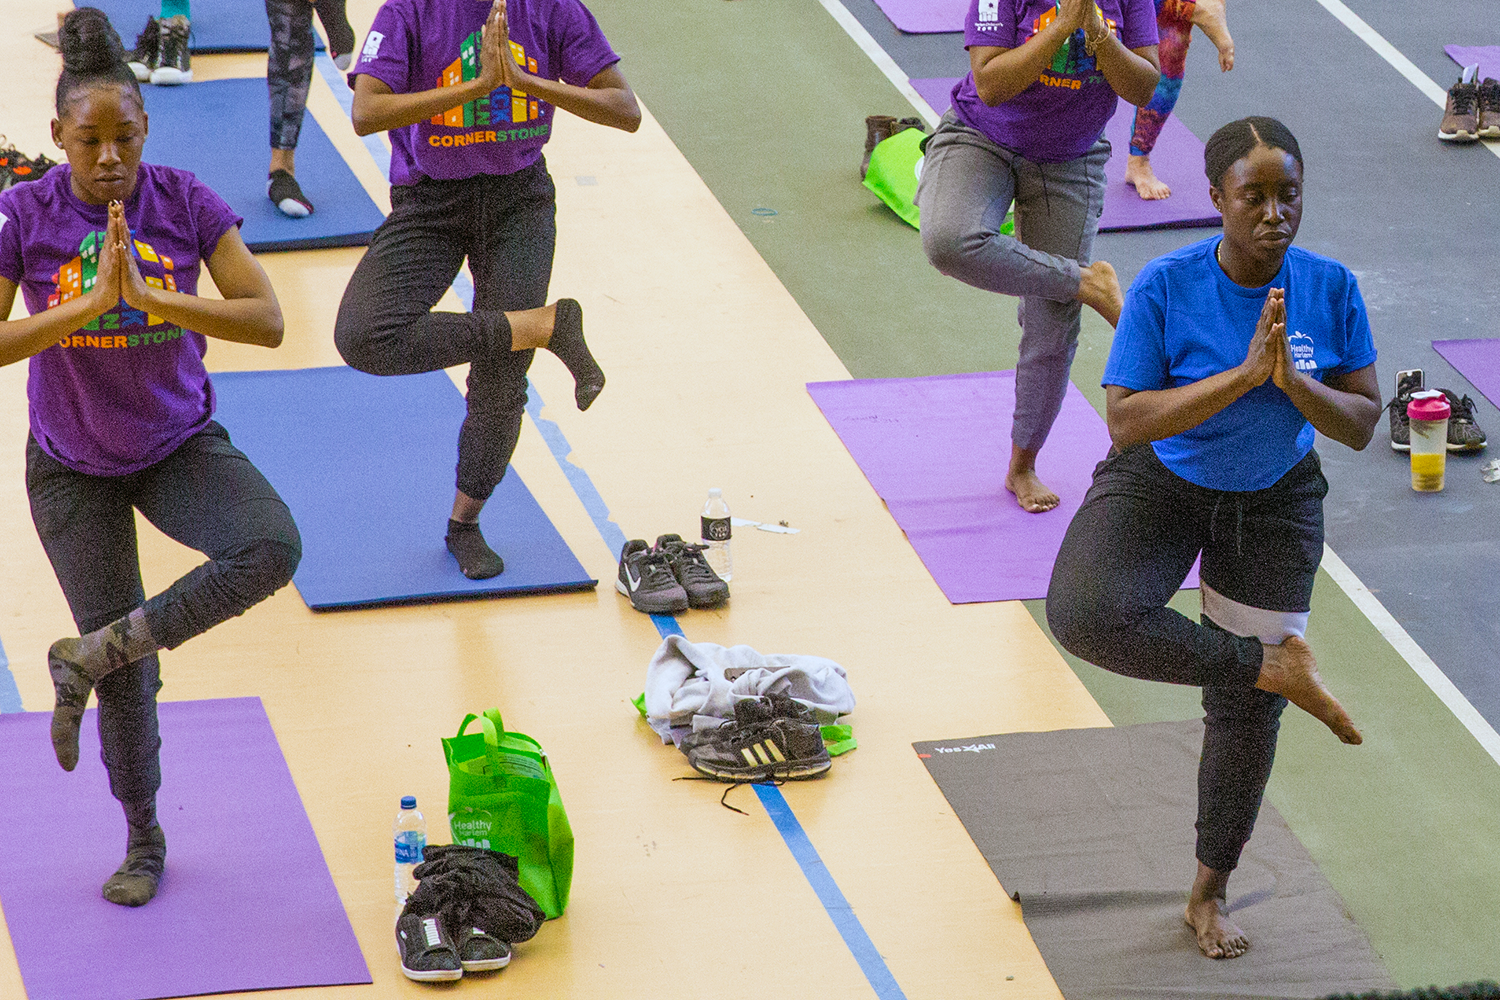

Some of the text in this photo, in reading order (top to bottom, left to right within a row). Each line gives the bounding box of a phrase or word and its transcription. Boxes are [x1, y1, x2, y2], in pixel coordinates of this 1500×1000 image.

[428, 123, 549, 148] CORNERSTONE
[59, 327, 187, 349] ORNERSTON
[453, 820, 492, 831] Healthy
